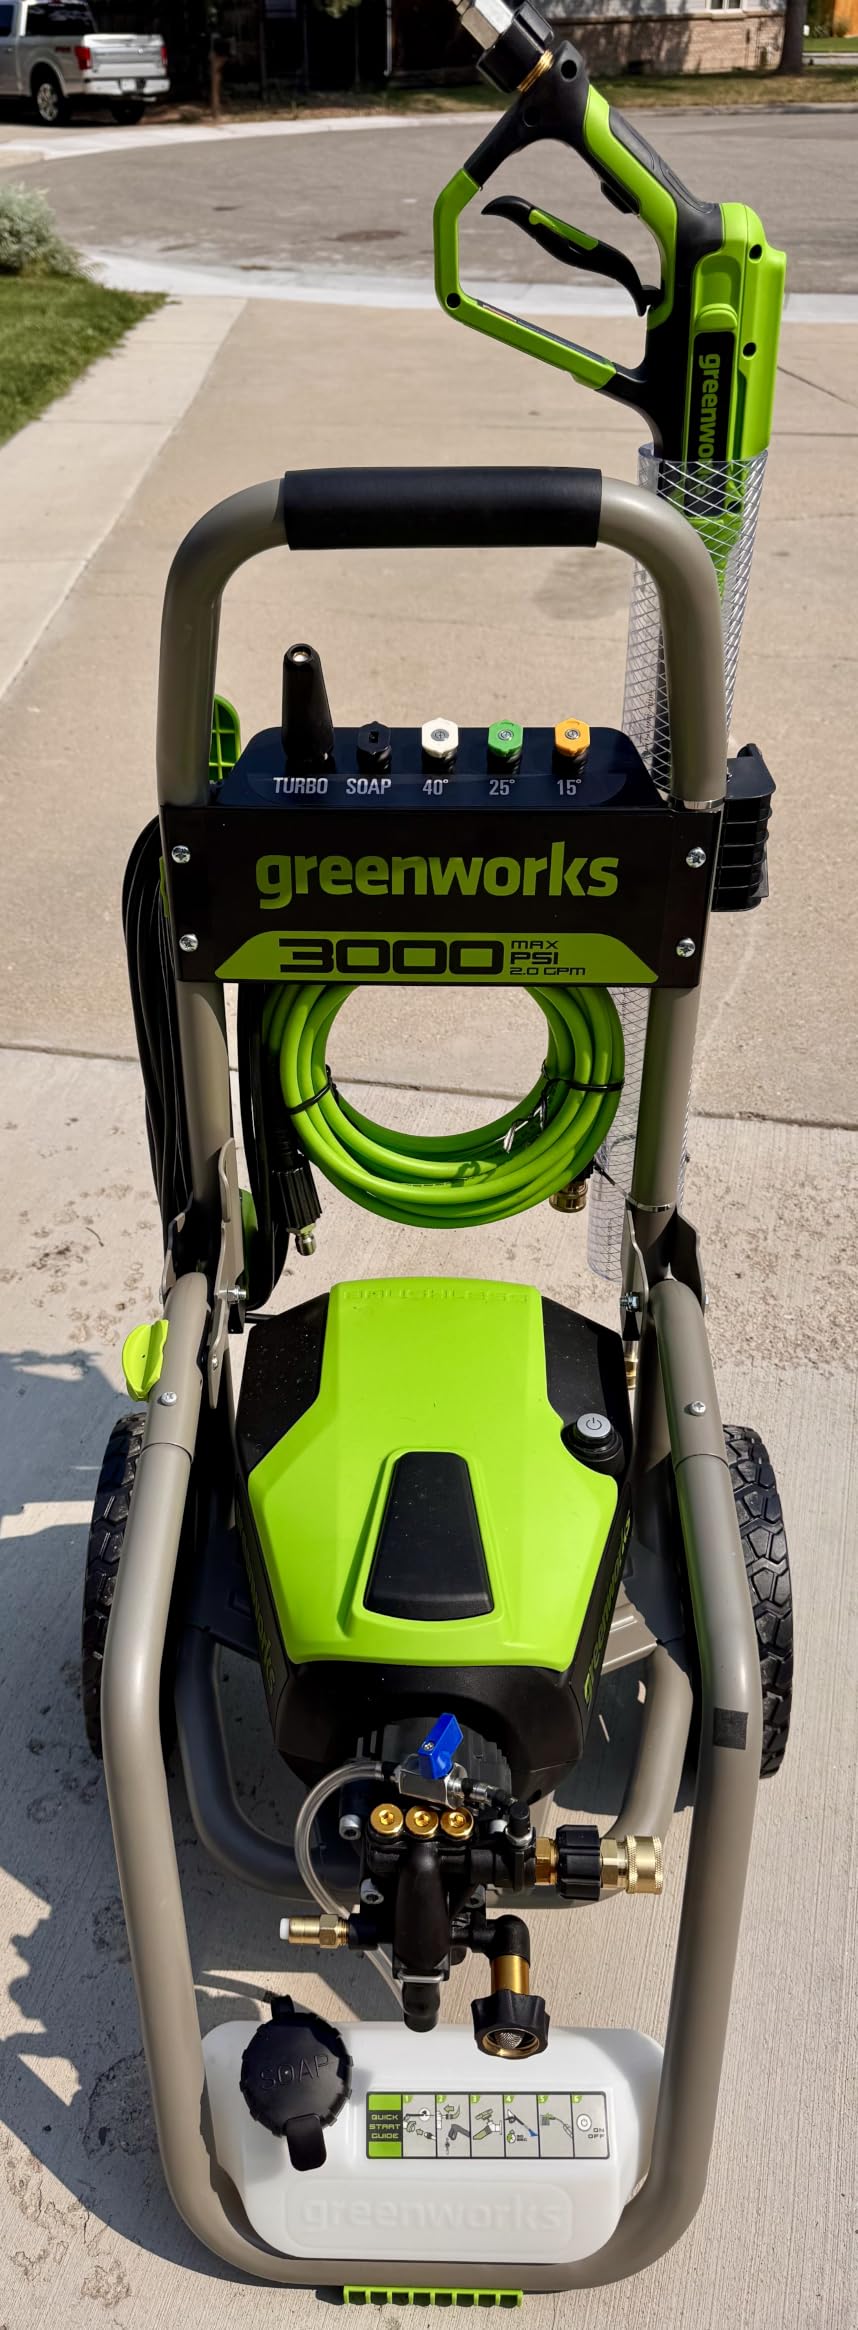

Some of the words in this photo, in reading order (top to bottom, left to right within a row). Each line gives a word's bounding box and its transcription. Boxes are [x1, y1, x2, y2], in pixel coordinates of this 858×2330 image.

[273, 777, 329, 794] TURBO
[345, 778, 392, 795] SOAP
[422, 778, 449, 796] 40°
[489, 778, 515, 796] 25°
[557, 778, 582, 796] 15°
[255, 841, 619, 910] greenworks
[278, 938, 504, 975] 3000
[511, 940, 559, 949] MAX
[511, 952, 559, 965] PSI
[510, 967, 539, 975] 2.0
[543, 967, 586, 976] GPM
[260, 2053, 329, 2092] SOAP
[303, 2194, 561, 2233] greenworks
